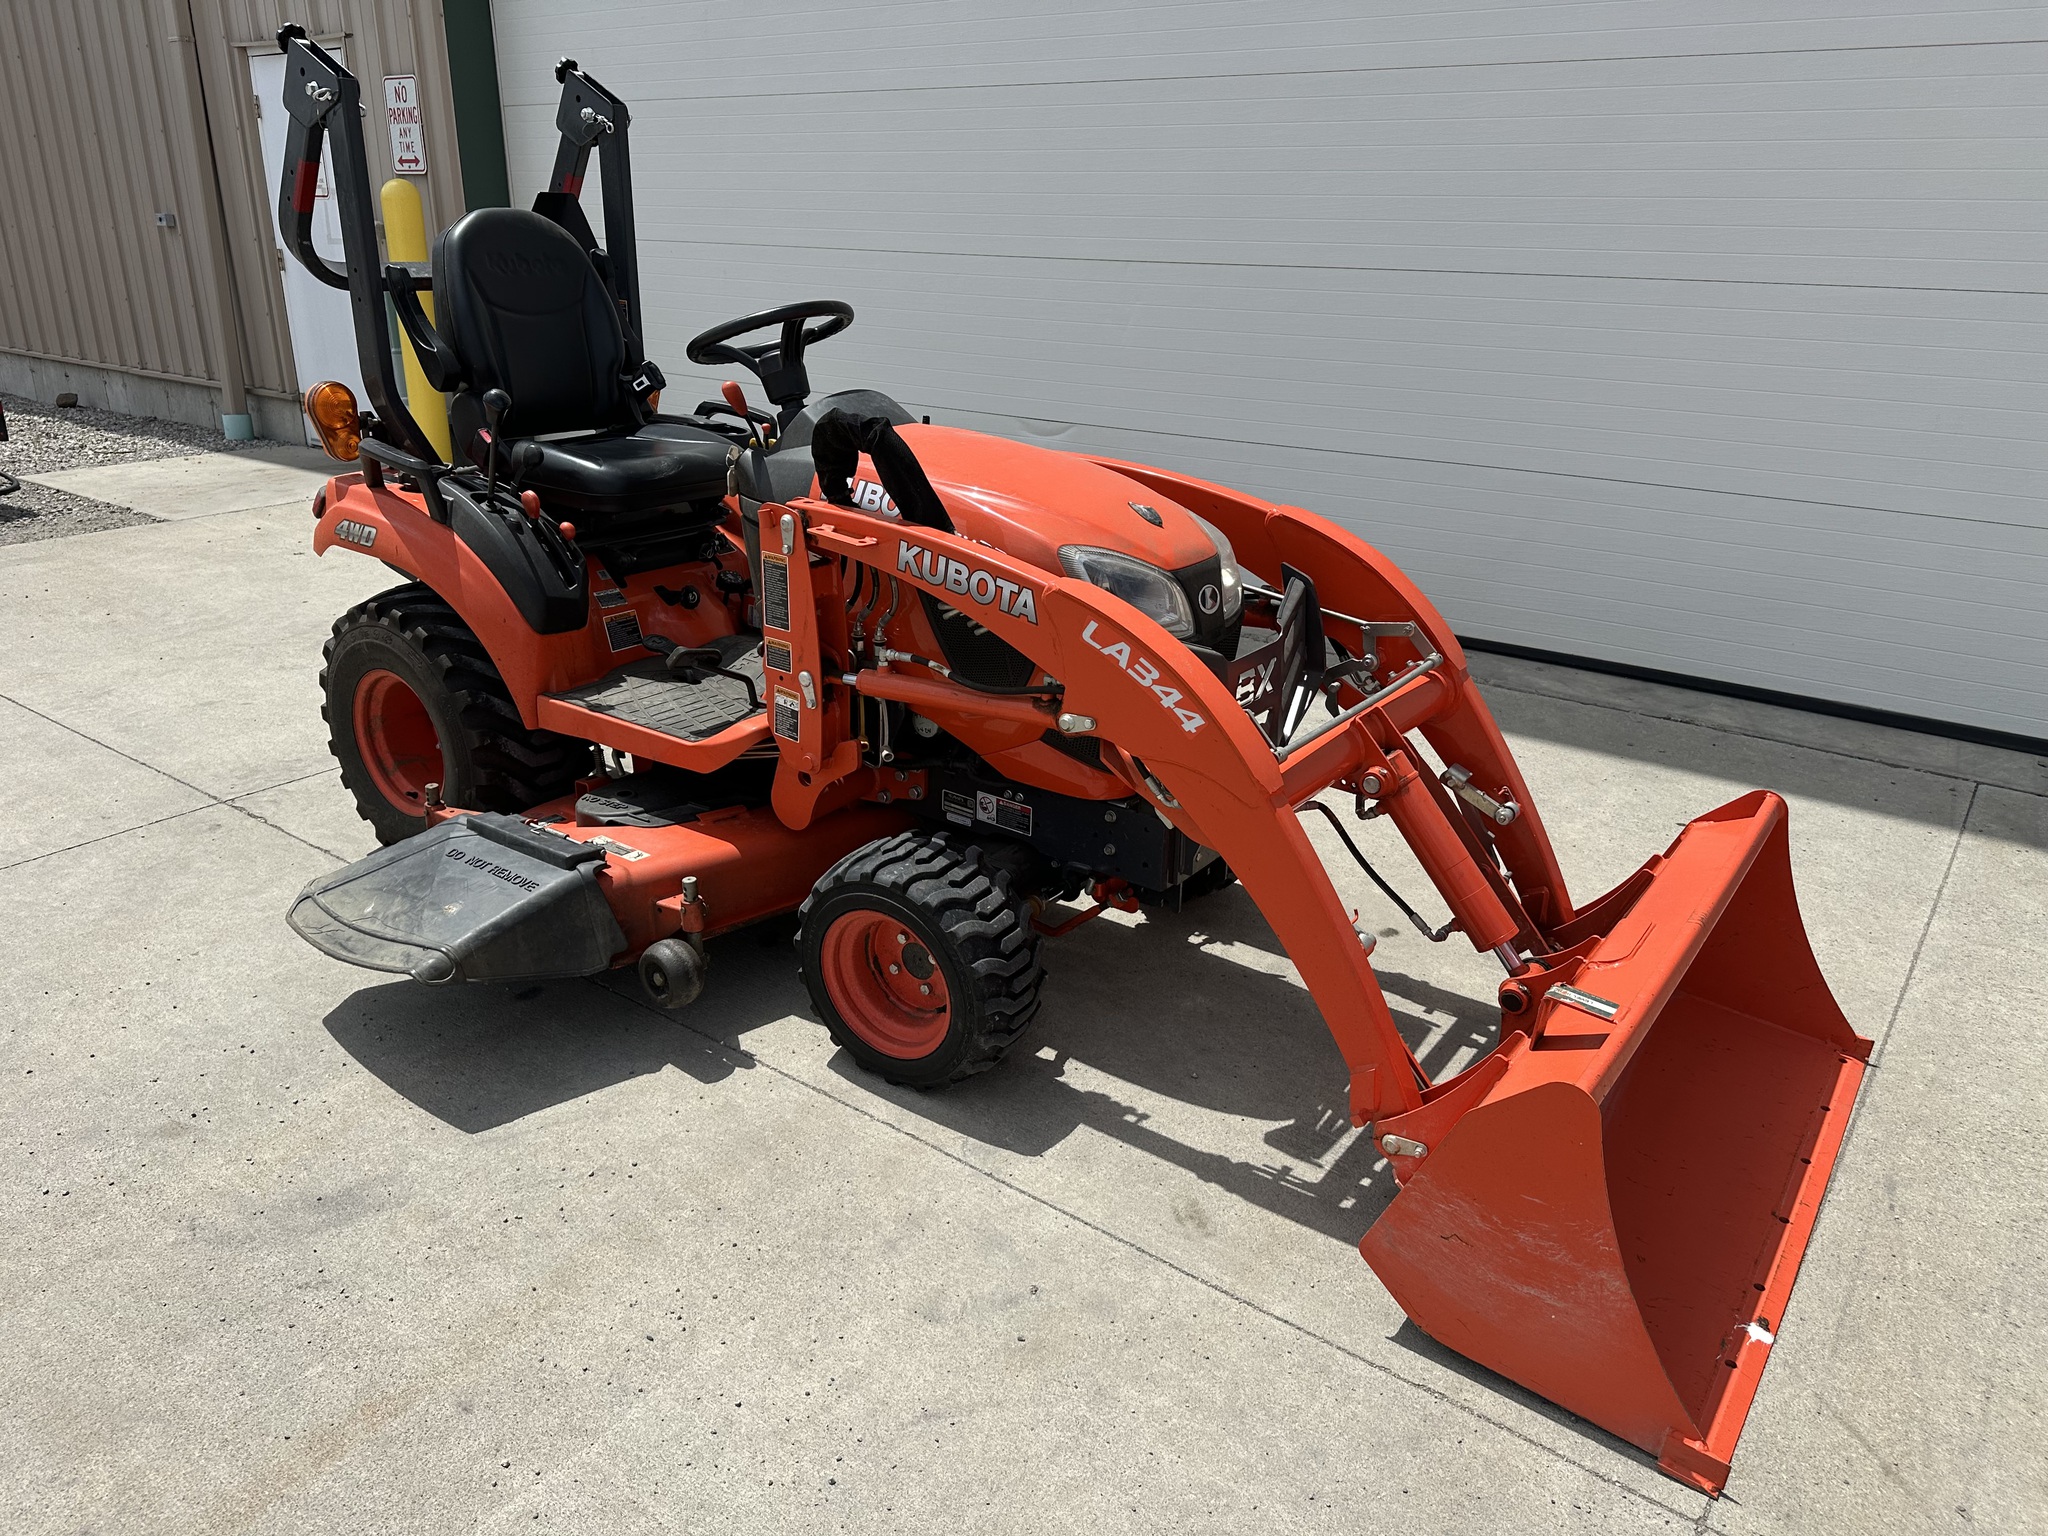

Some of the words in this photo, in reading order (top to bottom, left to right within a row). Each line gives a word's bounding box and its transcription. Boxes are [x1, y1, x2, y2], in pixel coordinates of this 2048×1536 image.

[394, 85, 408, 103] NO
[388, 106, 418, 125] PARKING
[399, 127, 412, 139] ANY
[399, 141, 415, 153] TIME
[334, 518, 377, 548] 4WD
[897, 539, 1038, 626] KUBOTA
[1082, 620, 1206, 734] LA344
[598, 799, 628, 810] STEP
[445, 848, 466, 860] DO
[464, 856, 493, 870] NOT
[487, 865, 540, 893] REMOVE
